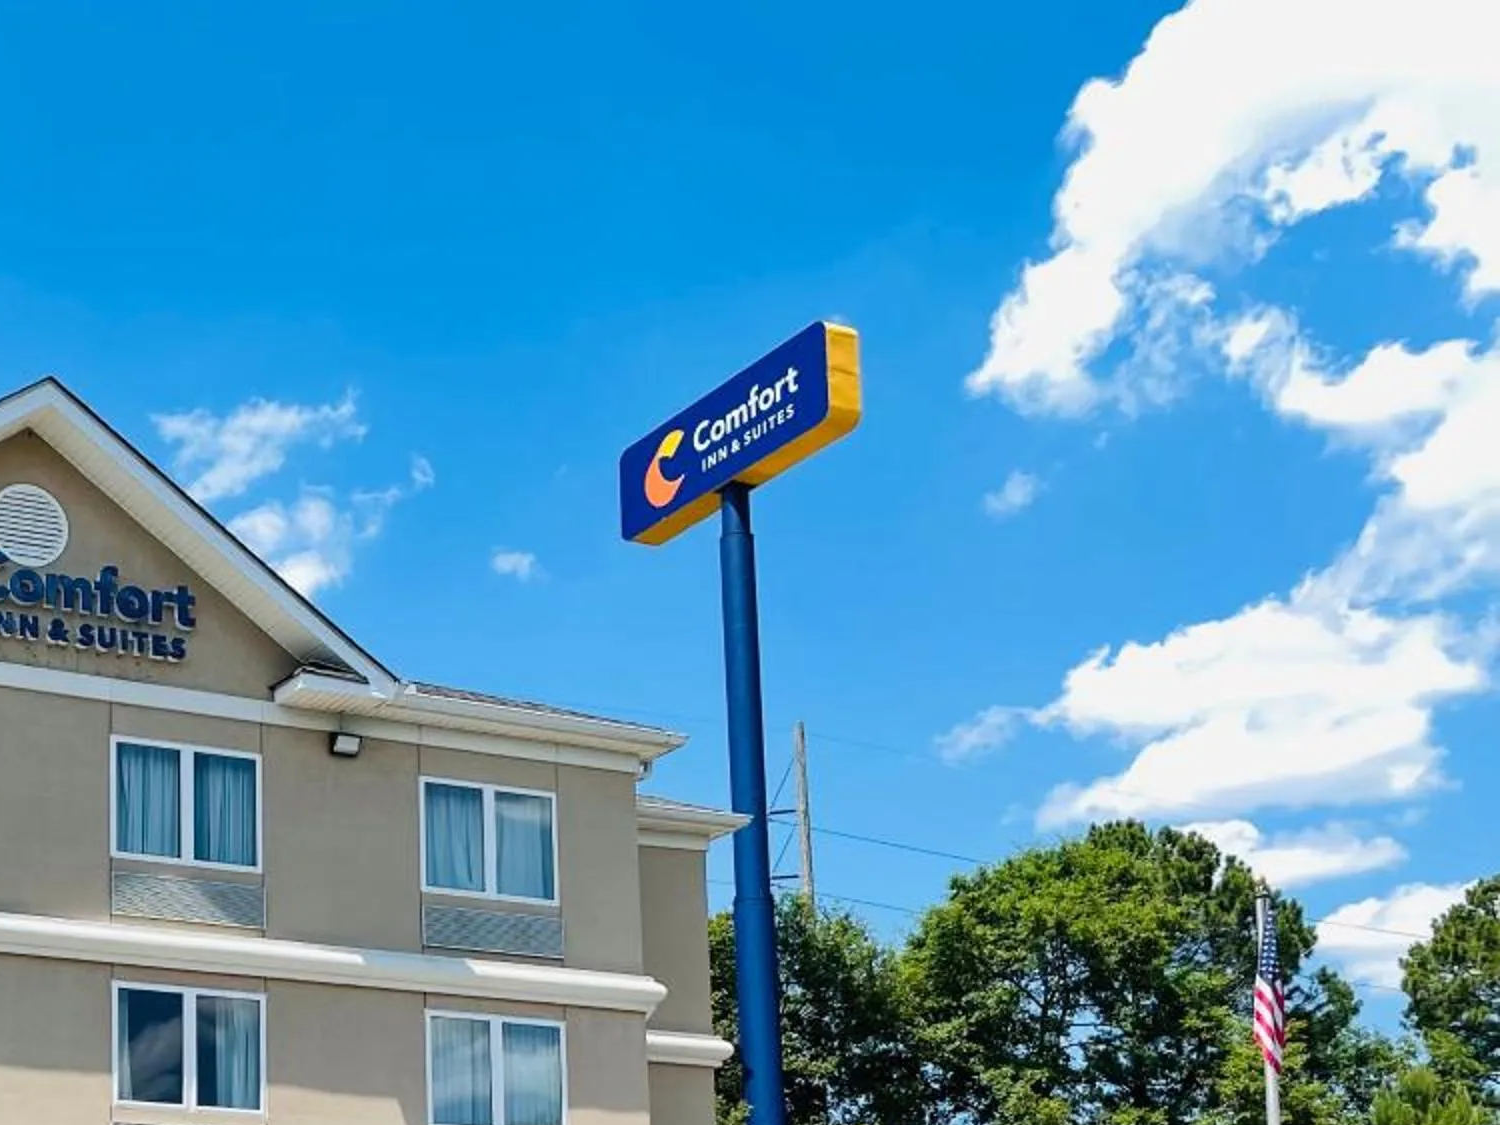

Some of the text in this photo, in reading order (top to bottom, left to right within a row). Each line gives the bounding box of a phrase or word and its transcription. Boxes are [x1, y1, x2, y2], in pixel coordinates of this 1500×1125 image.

[693, 367, 799, 451] Comfort
[701, 403, 795, 472] INN & SUITES
[46, 618, 70, 646] &
[75, 623, 186, 663] SUITES
